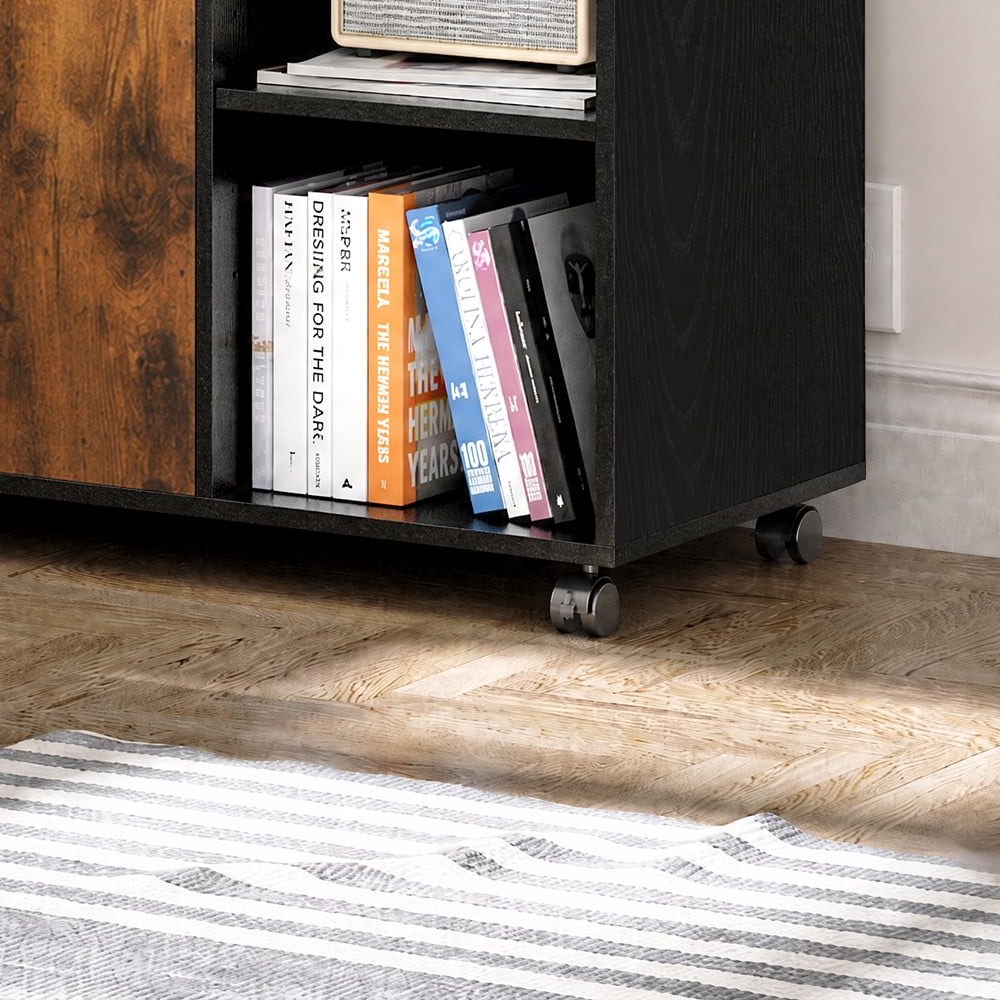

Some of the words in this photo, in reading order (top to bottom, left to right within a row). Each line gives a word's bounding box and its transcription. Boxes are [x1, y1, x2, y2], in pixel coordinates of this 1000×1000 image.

[312, 302, 325, 340] FOR
[377, 322, 391, 352] THE
[312, 345, 325, 383] THE
[460, 439, 489, 469] 100
